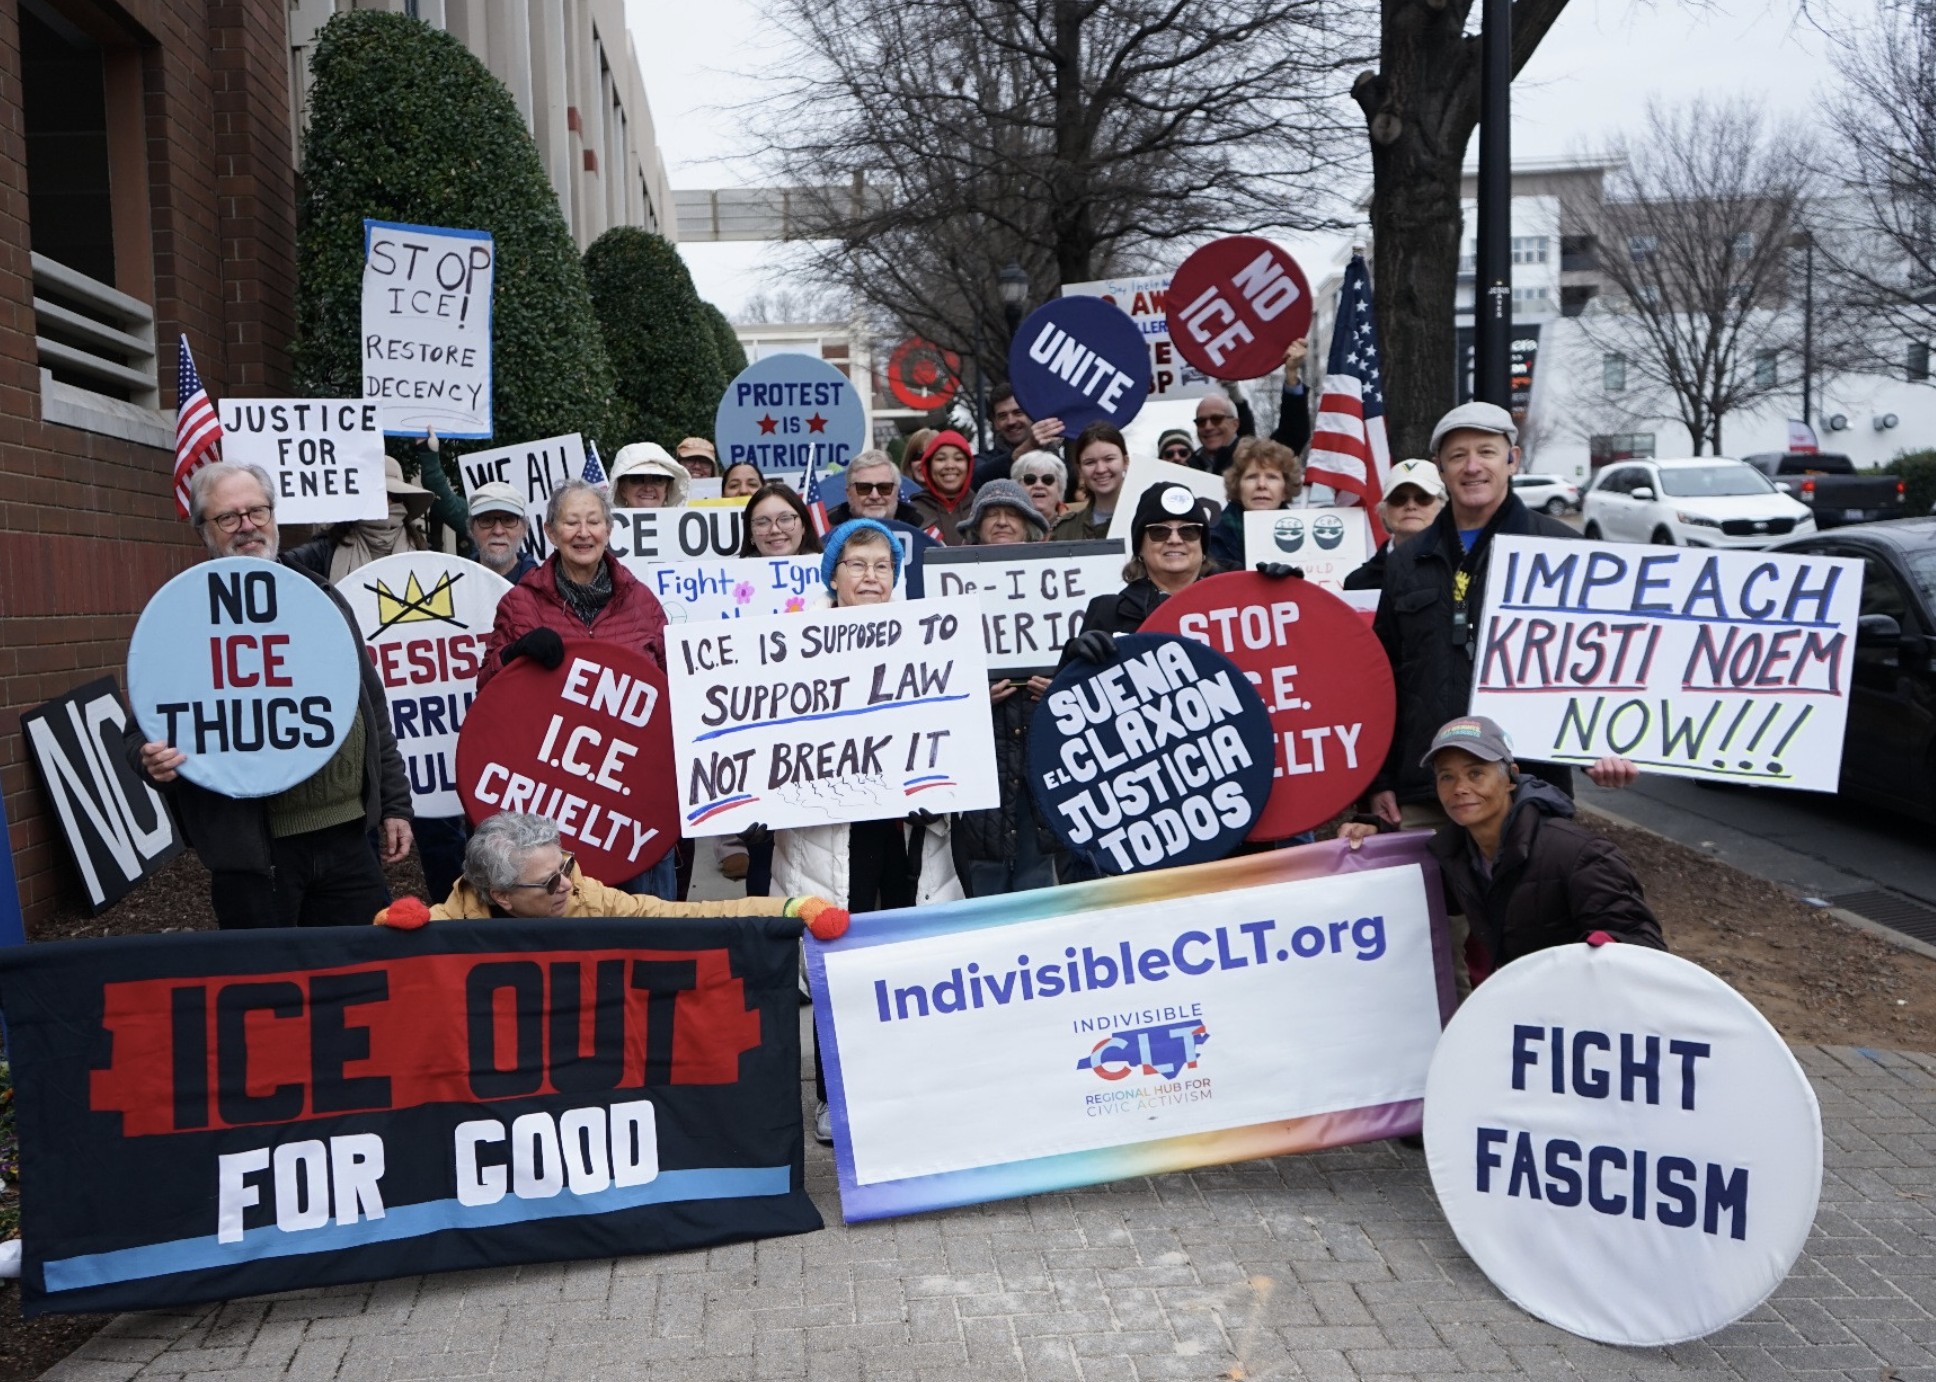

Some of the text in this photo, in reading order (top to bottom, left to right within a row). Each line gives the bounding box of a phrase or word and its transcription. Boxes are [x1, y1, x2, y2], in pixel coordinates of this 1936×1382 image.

[371, 240, 491, 294] STOP
[1231, 250, 1300, 322] NO
[388, 288, 469, 329] ICE!
[1178, 285, 1255, 367] ICE
[366, 334, 476, 367] RESTORE
[1029, 321, 1135, 414] UNITE
[225, 404, 376, 432] JUSTICE
[366, 375, 482, 411] DECENCY
[737, 382, 844, 407] PROTEST
[277, 438, 336, 466] FOR
[730, 443, 850, 467] PATRIOTIC
[783, 416, 801, 433] IS
[279, 468, 360, 498] ENEE
[608, 511, 745, 557] CE OU
[207, 571, 278, 625] NO
[657, 560, 820, 602] Fight Ign
[1502, 551, 1844, 623] IMPEACH
[681, 613, 958, 676] I.C.E. IS SUPPOSED TO
[1179, 601, 1300, 653] STOP
[1479, 615, 1848, 696] KRISTI NOEM
[210, 634, 293, 689] ICE
[1048, 641, 1199, 736] SUENA
[388, 692, 473, 740] RRU
[561, 657, 659, 728] END
[701, 659, 954, 727] SUPPORT LAW
[156, 695, 335, 755] THUGS
[537, 714, 640, 796] I.C.E.
[1043, 669, 1244, 790] EL CLAXON
[1553, 696, 1815, 775] NOW!!!
[689, 729, 951, 806] NOT BREAK IT
[1057, 724, 1254, 845] JUSTICIA
[474, 761, 660, 863] CRUELTY
[1098, 781, 1252, 873] TODOS
[874, 915, 1387, 1023] IndivisibleCLT.org
[170, 957, 698, 1131] ICE OUT
[1073, 1002, 1203, 1034] INDIVISIBLE
[1090, 1024, 1207, 1081] CLT
[1511, 1023, 1711, 1111] FIGHT
[1085, 1078, 1211, 1105] REGIONAL HUB FOR
[1087, 1089, 1212, 1117] CIVIC ACTIVISM
[218, 1099, 660, 1244] FOR GOOD
[1476, 1126, 1750, 1241] FASCISM
